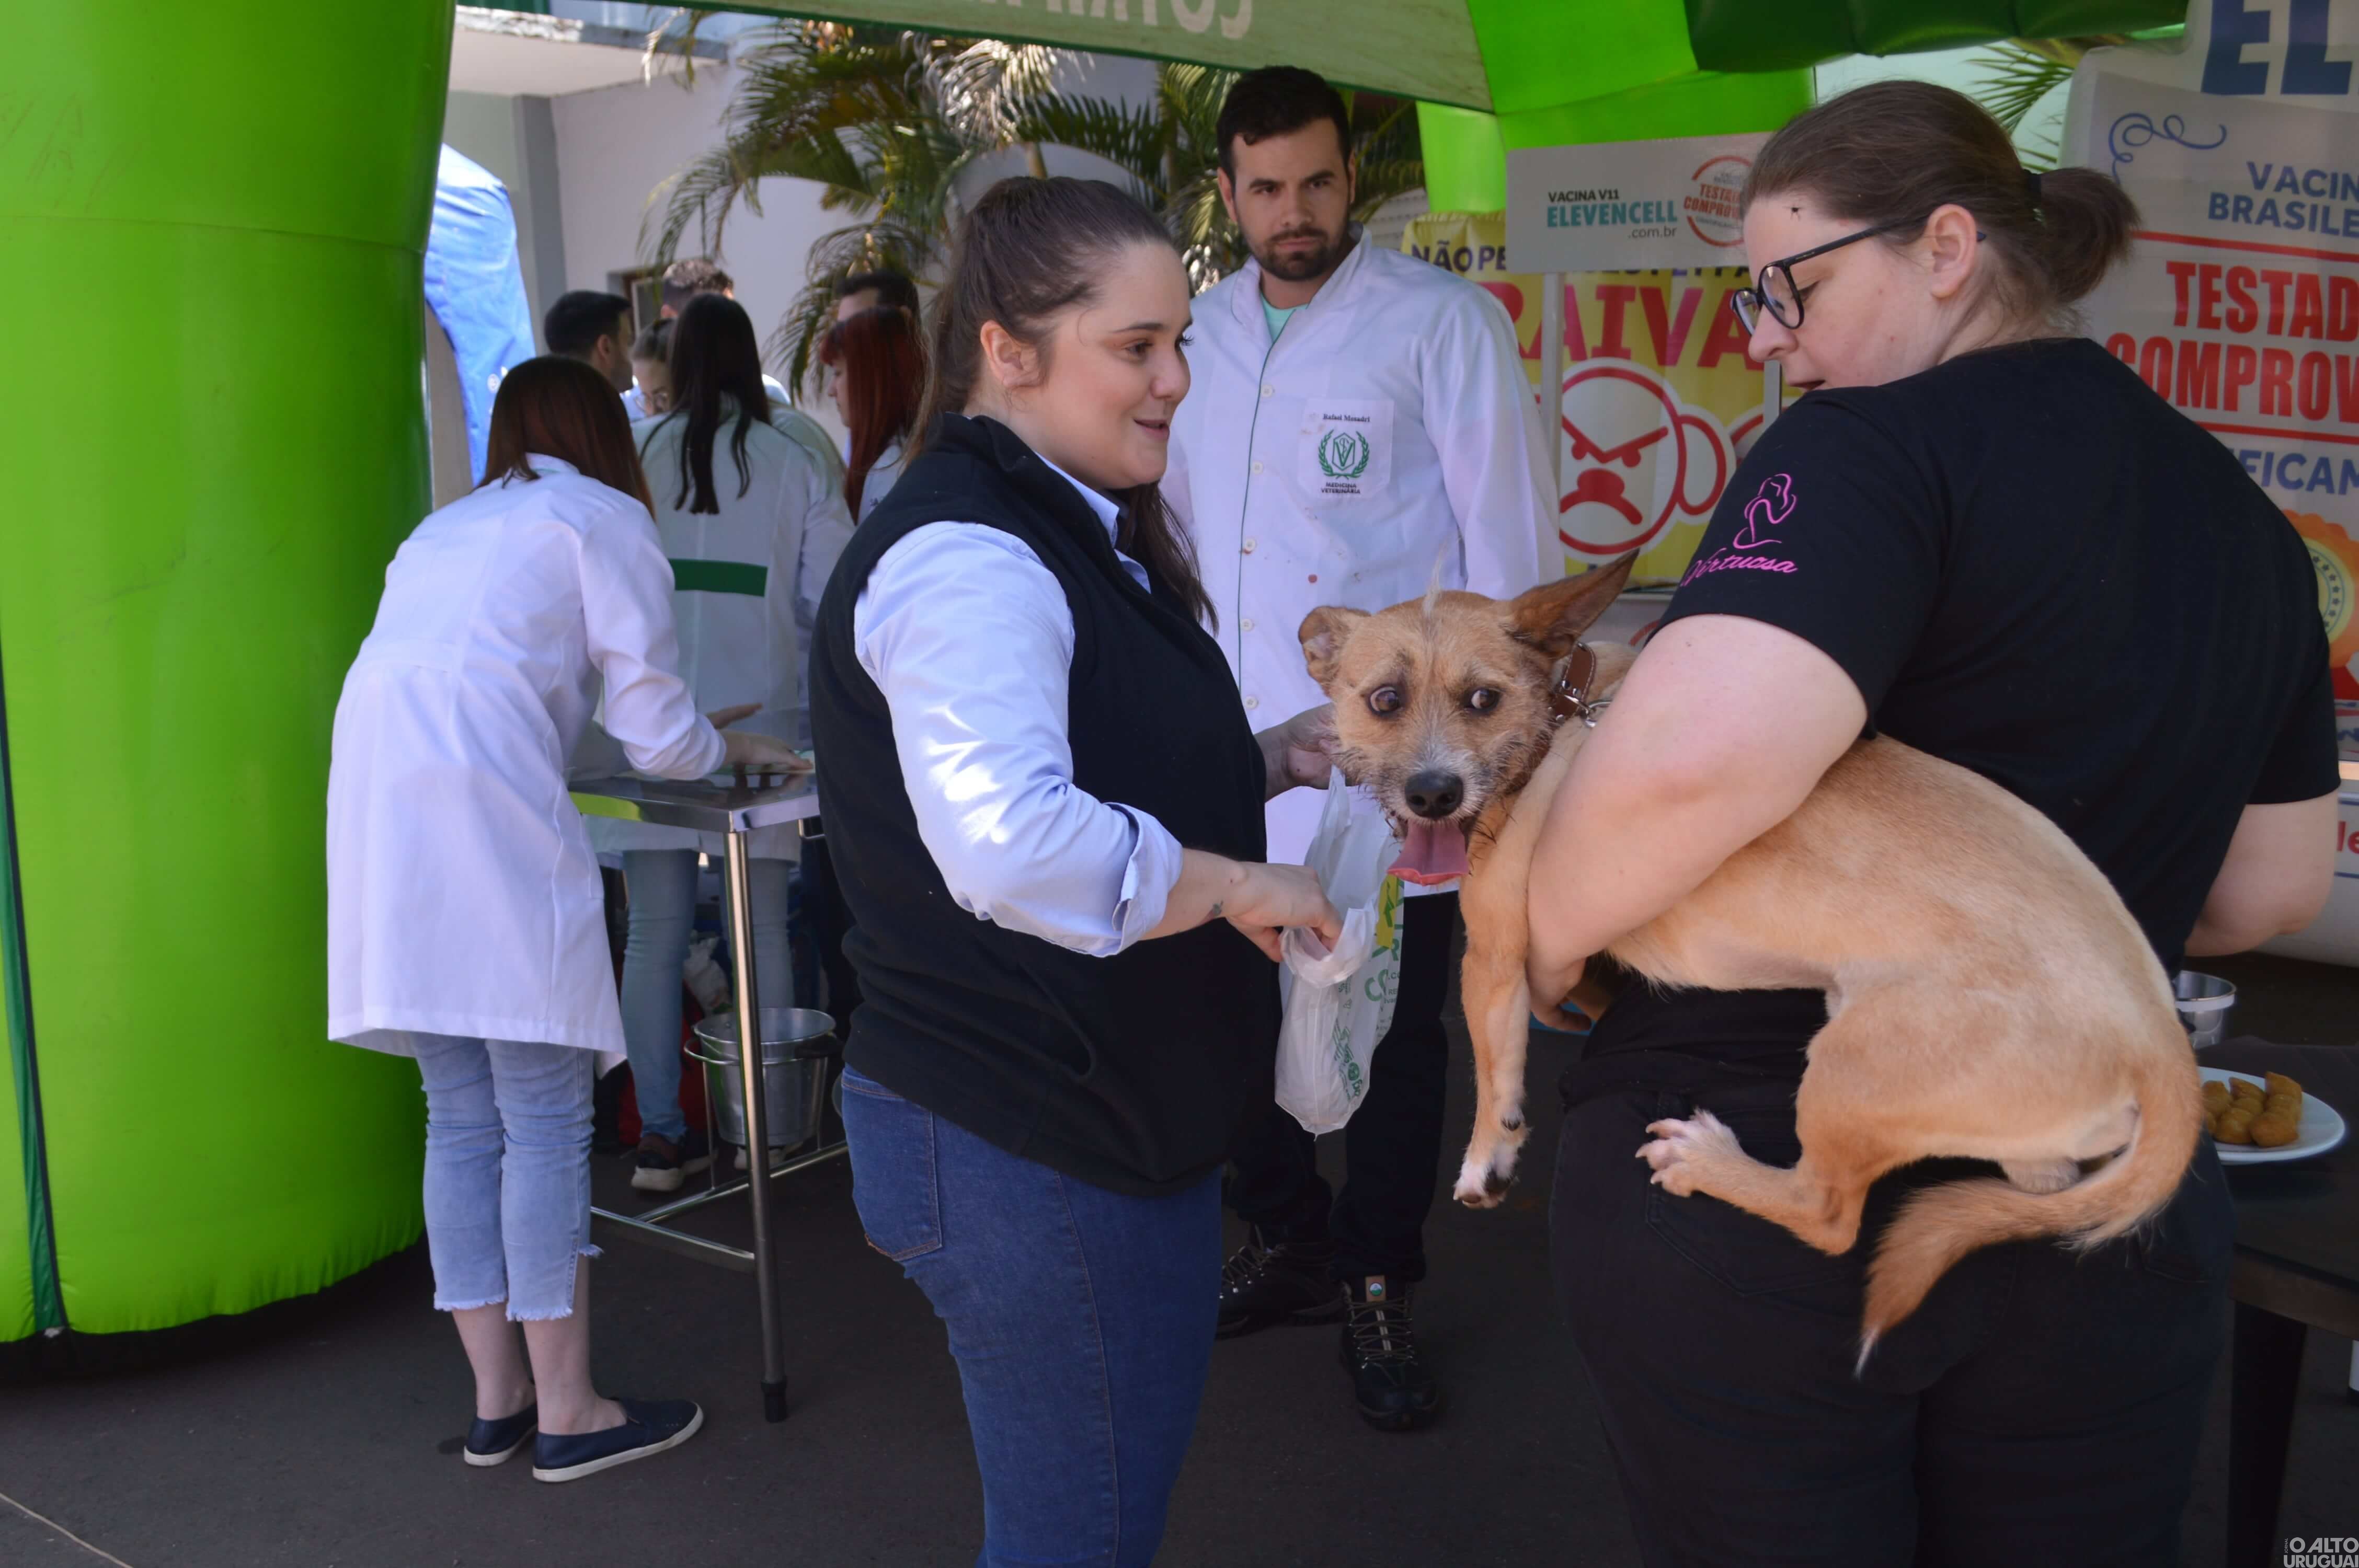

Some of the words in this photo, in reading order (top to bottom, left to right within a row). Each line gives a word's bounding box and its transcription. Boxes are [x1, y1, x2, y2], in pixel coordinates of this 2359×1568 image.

[1548, 190, 1596, 202] VACINA
[1599, 189, 1619, 200] V11
[2247, 161, 2359, 203] VACIN
[1547, 200, 1678, 227] ELEVENCELL
[1628, 225, 1677, 239] .com.br
[2208, 192, 2359, 238] BRASILE
[1412, 240, 1473, 272] NÃO
[2166, 261, 2359, 342] TESTAD
[2228, 448, 2359, 495] FICAM
[1680, 547, 1798, 586] Virtuosa
